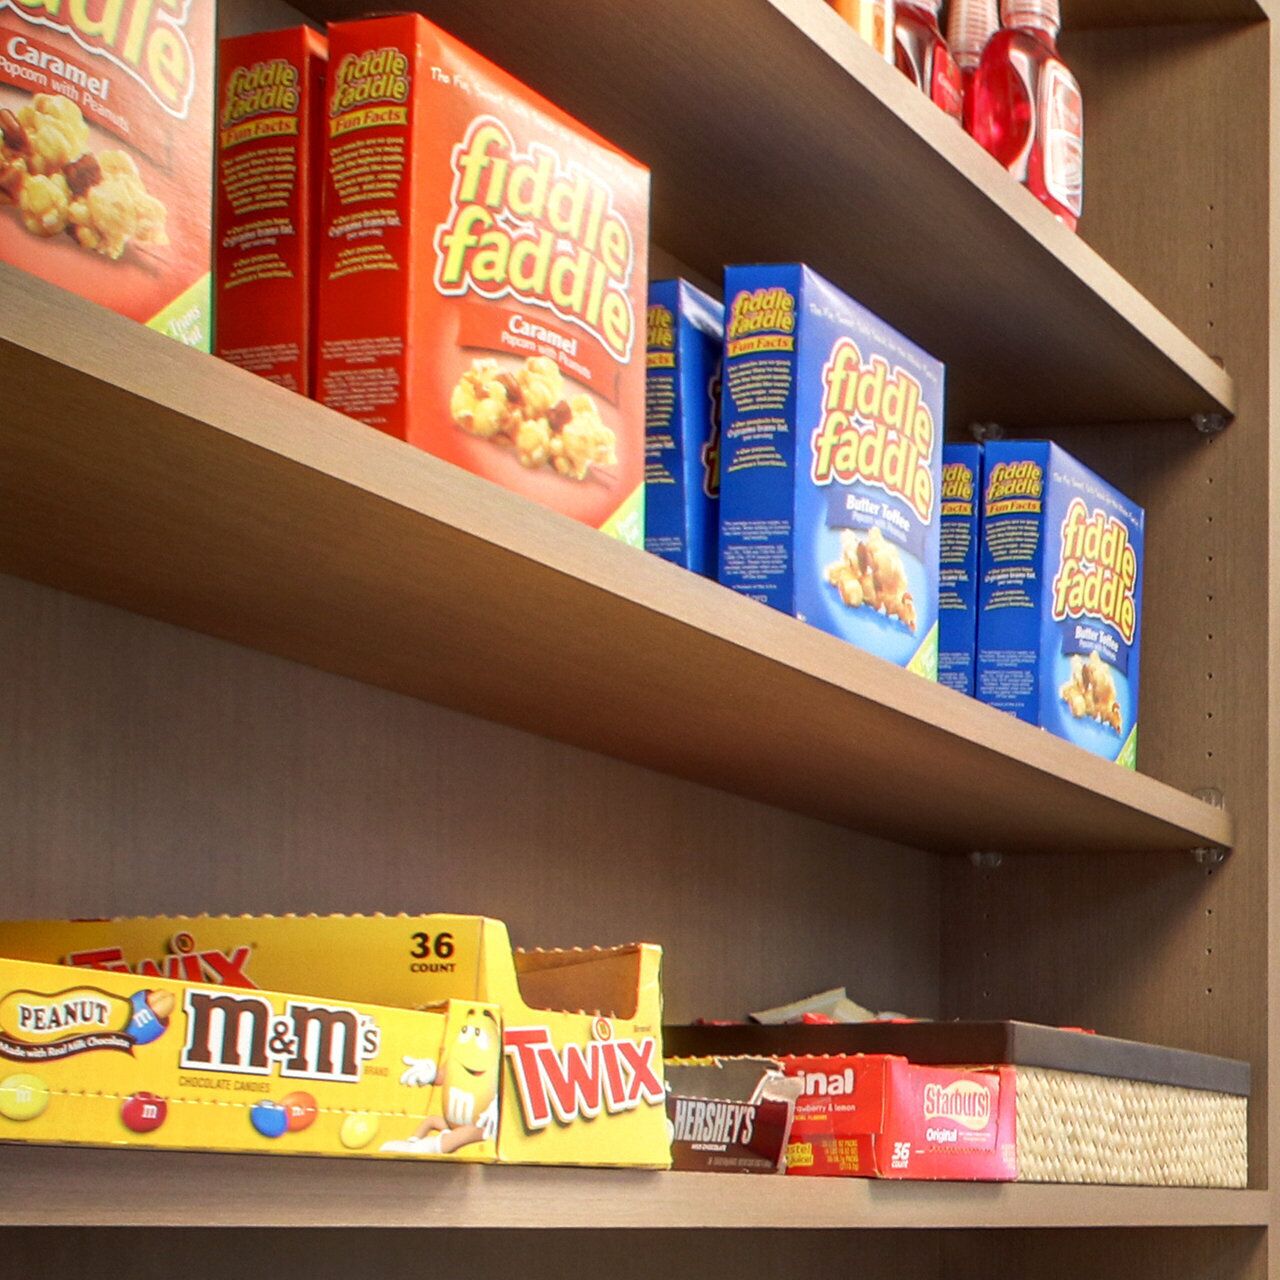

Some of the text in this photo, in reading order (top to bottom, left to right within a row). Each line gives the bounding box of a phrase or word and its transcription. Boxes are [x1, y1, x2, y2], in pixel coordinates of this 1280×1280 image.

[7, 36, 110, 100] Caramel
[229, 62, 295, 92] fiddle
[339, 49, 406, 81] fiddle
[0, 56, 130, 134] Popcorn with Peanuts
[224, 85, 296, 126] faddle
[332, 74, 407, 115] faddle
[254, 119, 291, 135] Facts
[335, 109, 401, 132] Fun Facts
[459, 125, 628, 278] fiddle
[443, 207, 631, 352] faddle
[737, 289, 793, 315] fiddle
[508, 314, 577, 357] Caramel
[731, 311, 793, 337] faddle
[501, 331, 538, 352] Popcorn
[733, 337, 789, 353] Fun Facts
[828, 345, 931, 456] fiddle
[817, 412, 931, 521] faddle
[993, 462, 1041, 482] fiddle
[988, 478, 1041, 500] faddle
[846, 494, 911, 532] Butter Toffee
[990, 502, 1037, 513] Fun Facts
[1064, 503, 1135, 588] fiddle
[1056, 558, 1135, 641] faddle
[1075, 625, 1097, 643] Butter
[1097, 630, 1120, 653] Toffee
[411, 932, 455, 959] 36
[410, 962, 457, 973] COUNT
[20, 1001, 108, 1031] PEANUT
[0, 1036, 131, 1058] Made with Real Milk Chocolate
[179, 1076, 270, 1093] CHOCOLATE CANDIES
[142, 1103, 158, 1119] m
[834, 1103, 857, 1112] lemon
[924, 1083, 991, 1120] Starburst
[674, 1098, 755, 1145] HERSHEY'S
[926, 1128, 958, 1143] Original
[891, 1142, 911, 1160] 36
[891, 1159, 909, 1169] count
